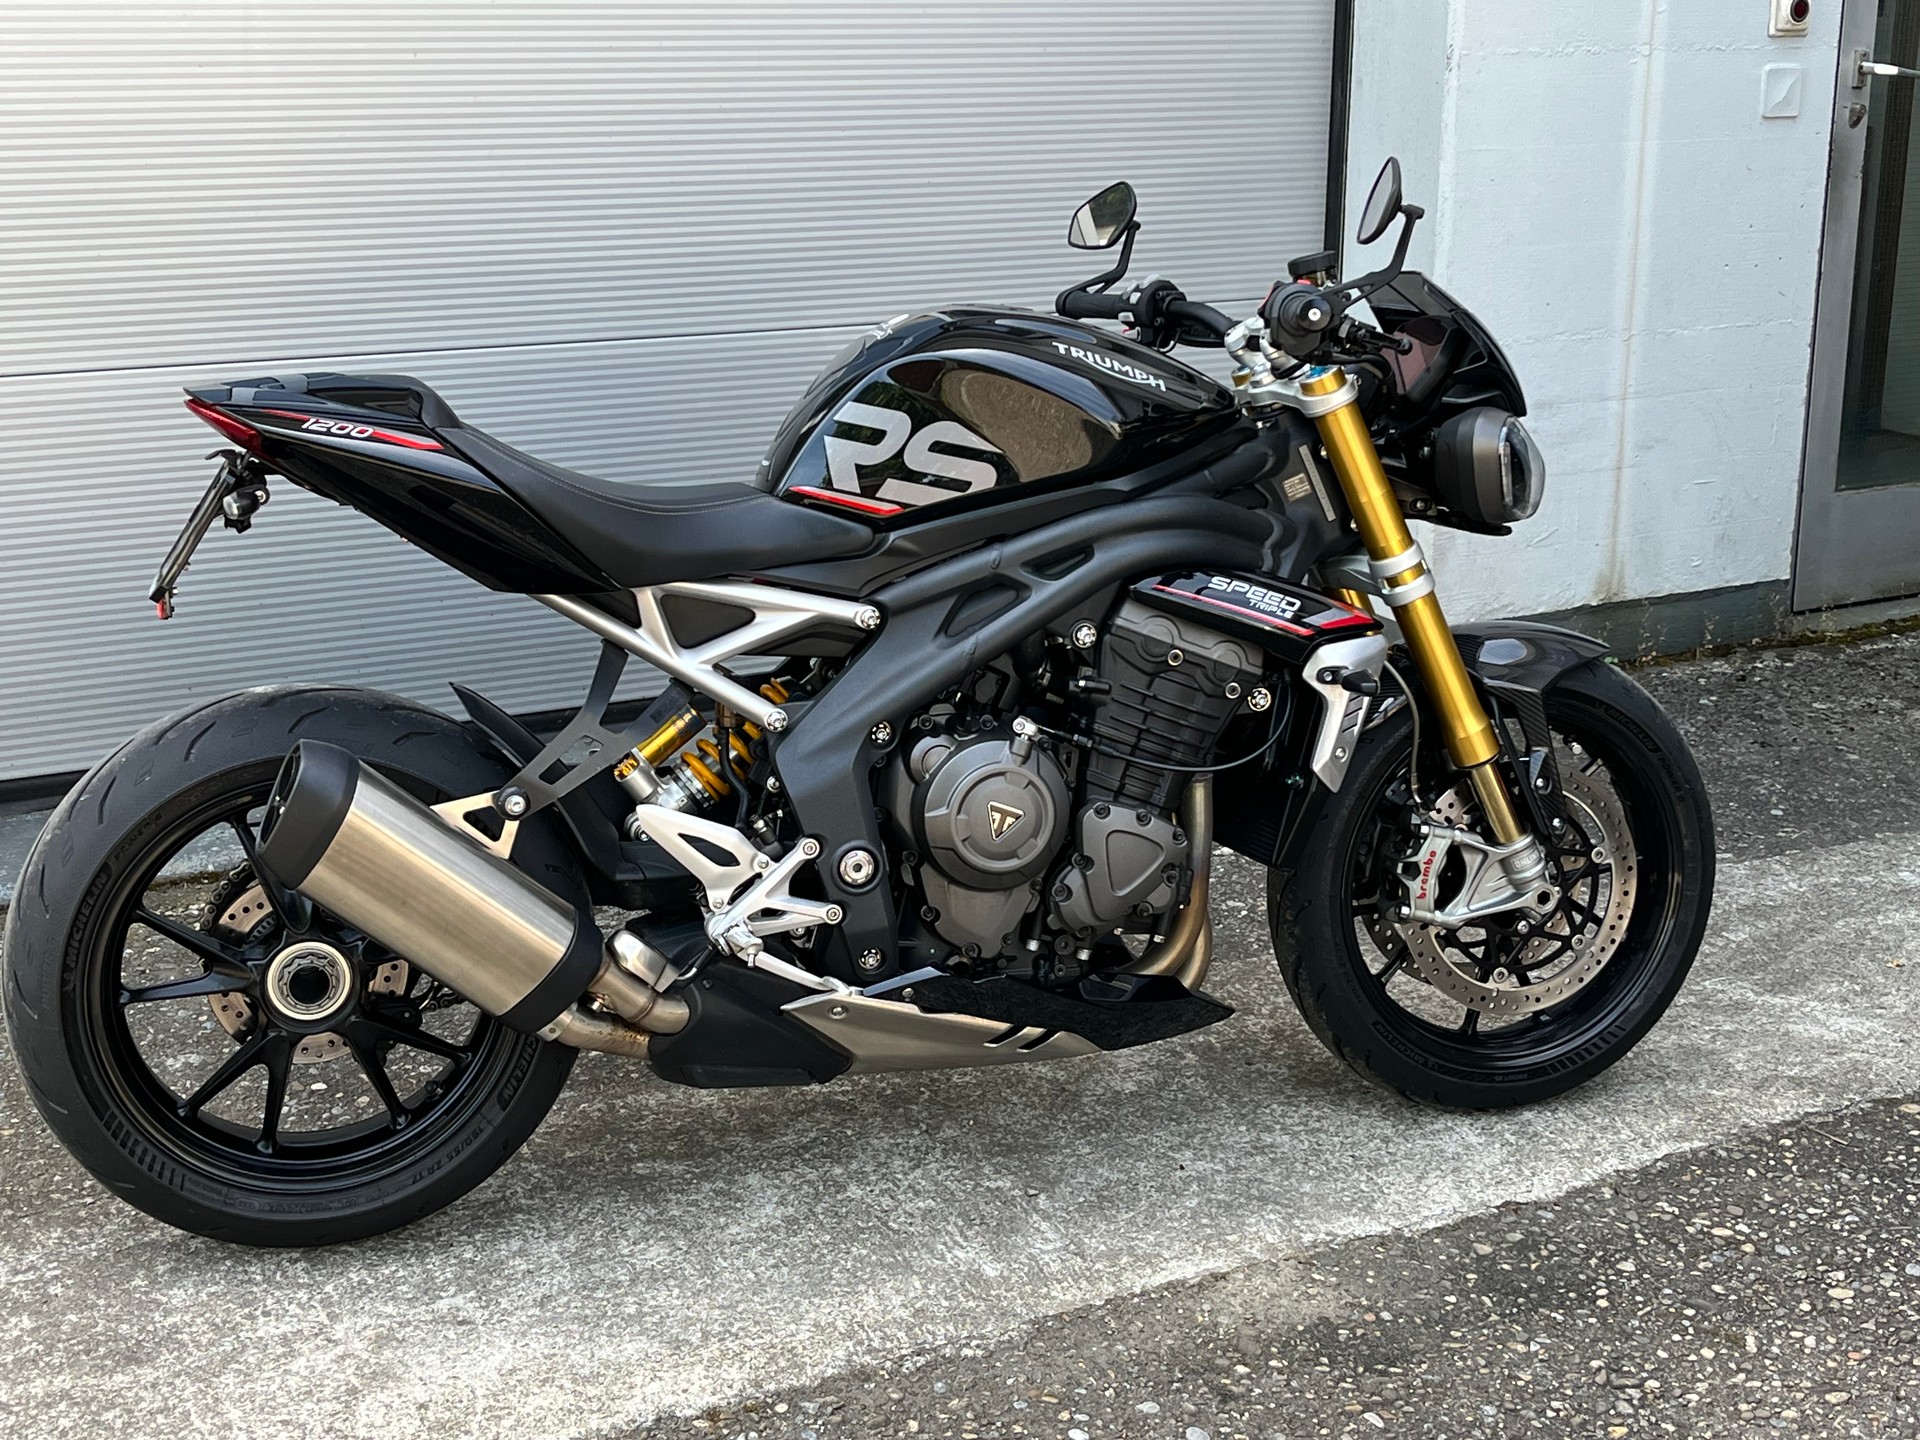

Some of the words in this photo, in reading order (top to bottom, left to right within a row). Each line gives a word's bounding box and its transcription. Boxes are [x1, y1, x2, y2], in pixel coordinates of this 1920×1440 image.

[1052, 341, 1167, 392] TRIUMPH
[301, 418, 375, 438] 1200
[823, 400, 1002, 506] RS
[1207, 576, 1302, 612] SPEED
[1249, 599, 1295, 619] TRIPLE
[1416, 850, 1437, 899] brembo
[65, 872, 110, 967] MICHELIN
[503, 1034, 536, 1102] CHELIN
